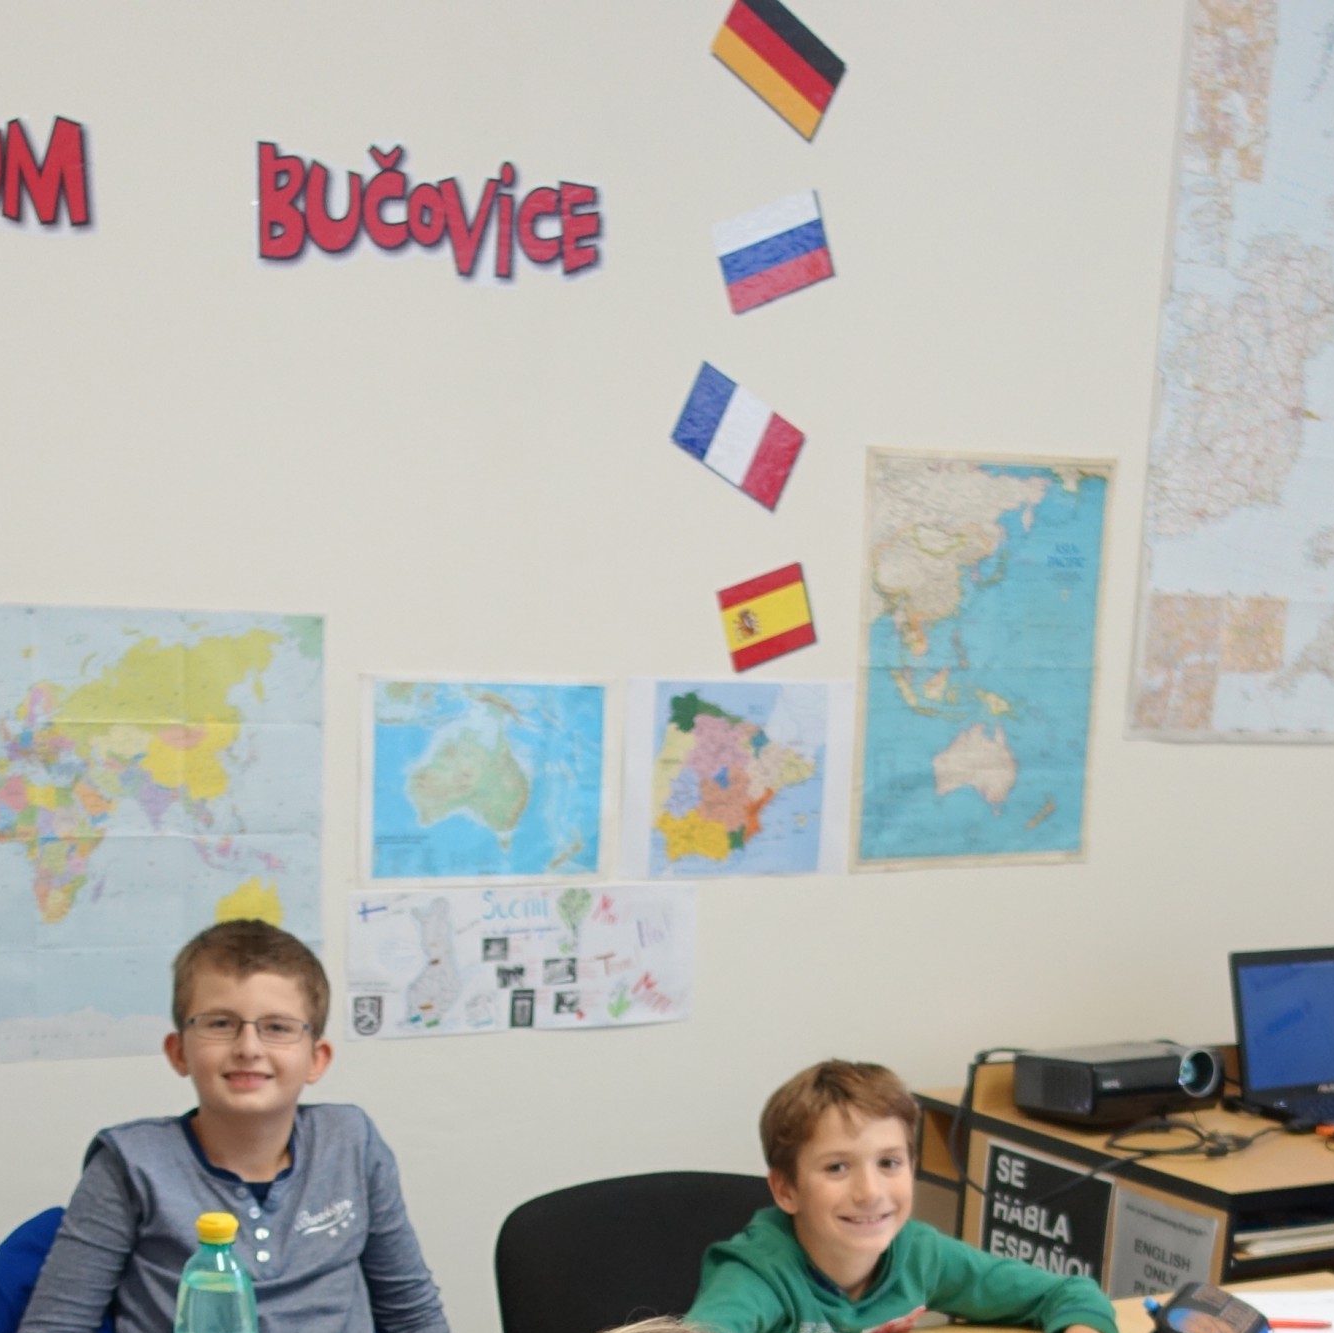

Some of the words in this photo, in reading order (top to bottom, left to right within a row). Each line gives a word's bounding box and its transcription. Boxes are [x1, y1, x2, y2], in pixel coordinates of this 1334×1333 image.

[996, 1154, 1026, 1189] SE
[993, 1192, 1071, 1244] HABLA
[1134, 1238, 1190, 1273] ENGLISH
[1143, 1263, 1178, 1287] ONLY
